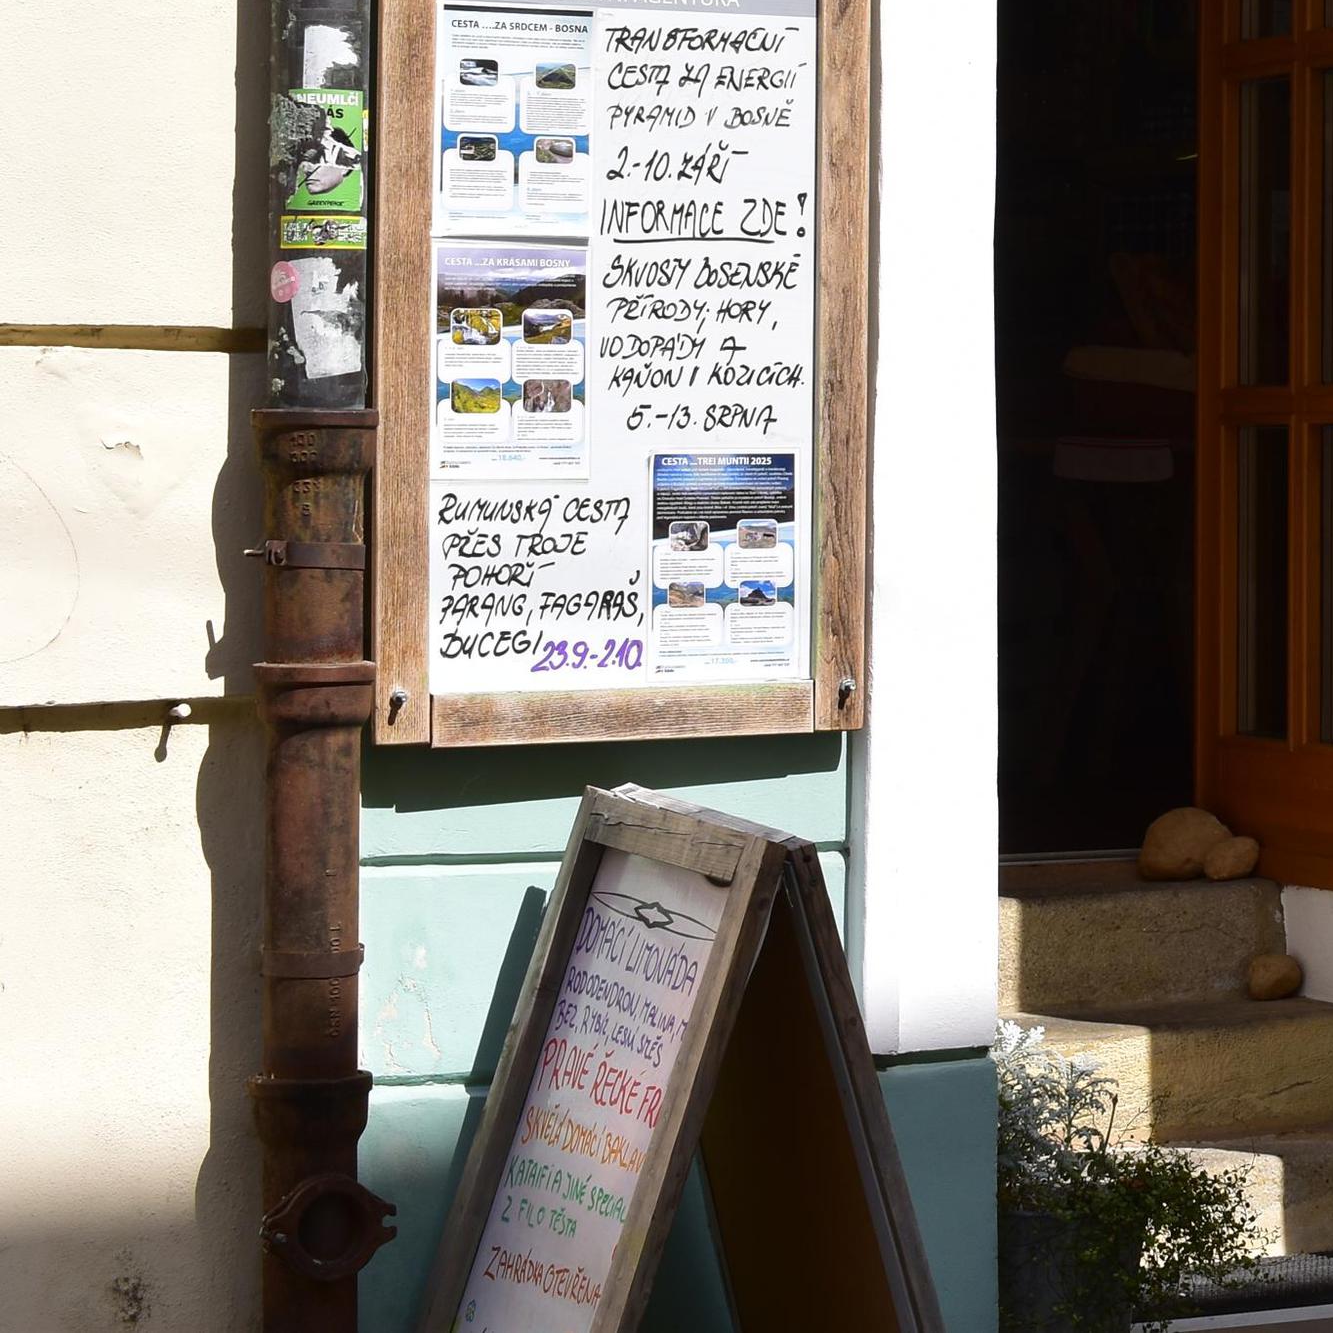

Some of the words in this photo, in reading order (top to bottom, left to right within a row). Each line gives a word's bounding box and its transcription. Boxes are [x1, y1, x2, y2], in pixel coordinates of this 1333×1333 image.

[452, 20, 479, 28] CESTA
[509, 23, 547, 31] SRDCEM
[555, 24, 588, 33] BOSNA
[607, 61, 671, 96] CESTA
[607, 104, 696, 132] PYRAMID
[600, 198, 723, 238] INFORMACE
[540, 259, 570, 267] BOSNY
[704, 403, 777, 435] SRPNA
[662, 457, 688, 465] CESTA
[751, 457, 771, 465] 2025
[563, 497, 630, 535] CESTA
[515, 532, 588, 557] TROJE
[537, 1038, 599, 1091] PRAVÉ
